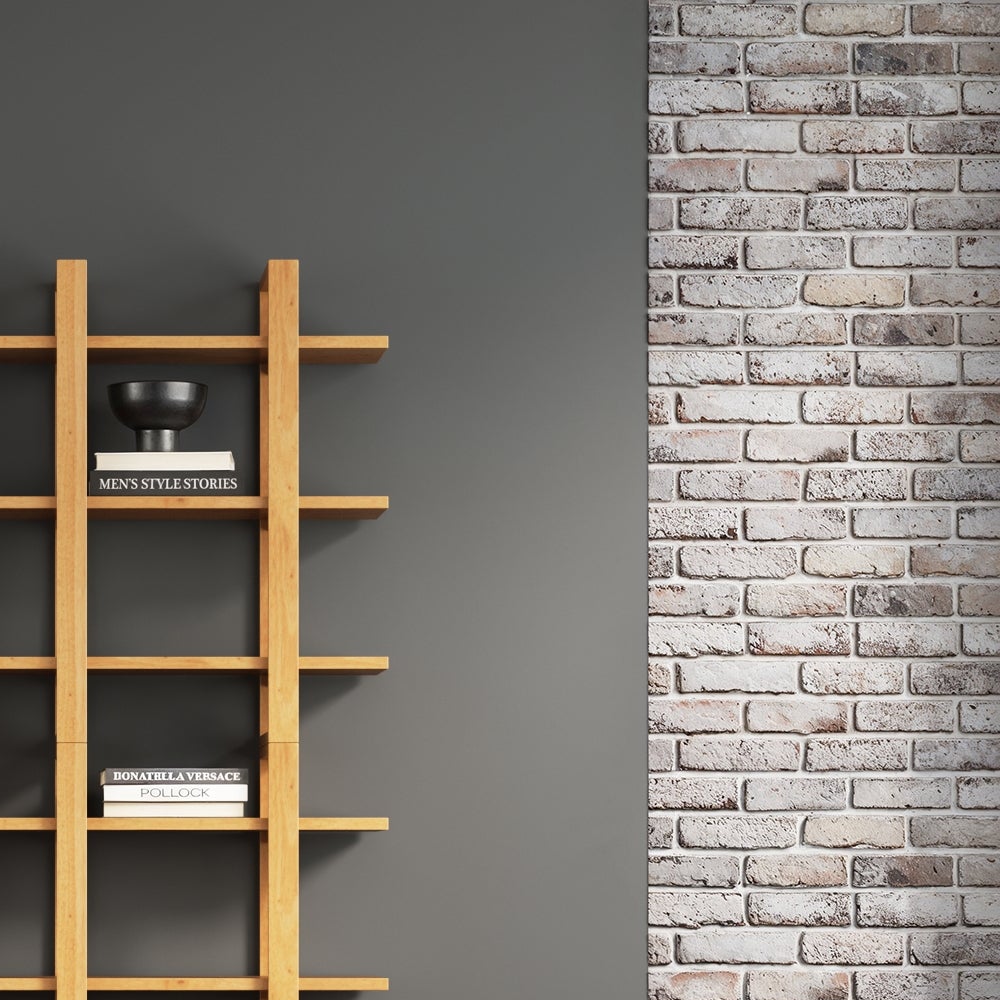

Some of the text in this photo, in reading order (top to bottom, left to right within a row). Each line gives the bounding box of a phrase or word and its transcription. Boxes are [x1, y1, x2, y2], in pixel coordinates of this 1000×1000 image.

[99, 477, 238, 490] MEN'S STYLE STORIES
[186, 771, 241, 781] VERSACE
[140, 787, 210, 798] POLLOCK
